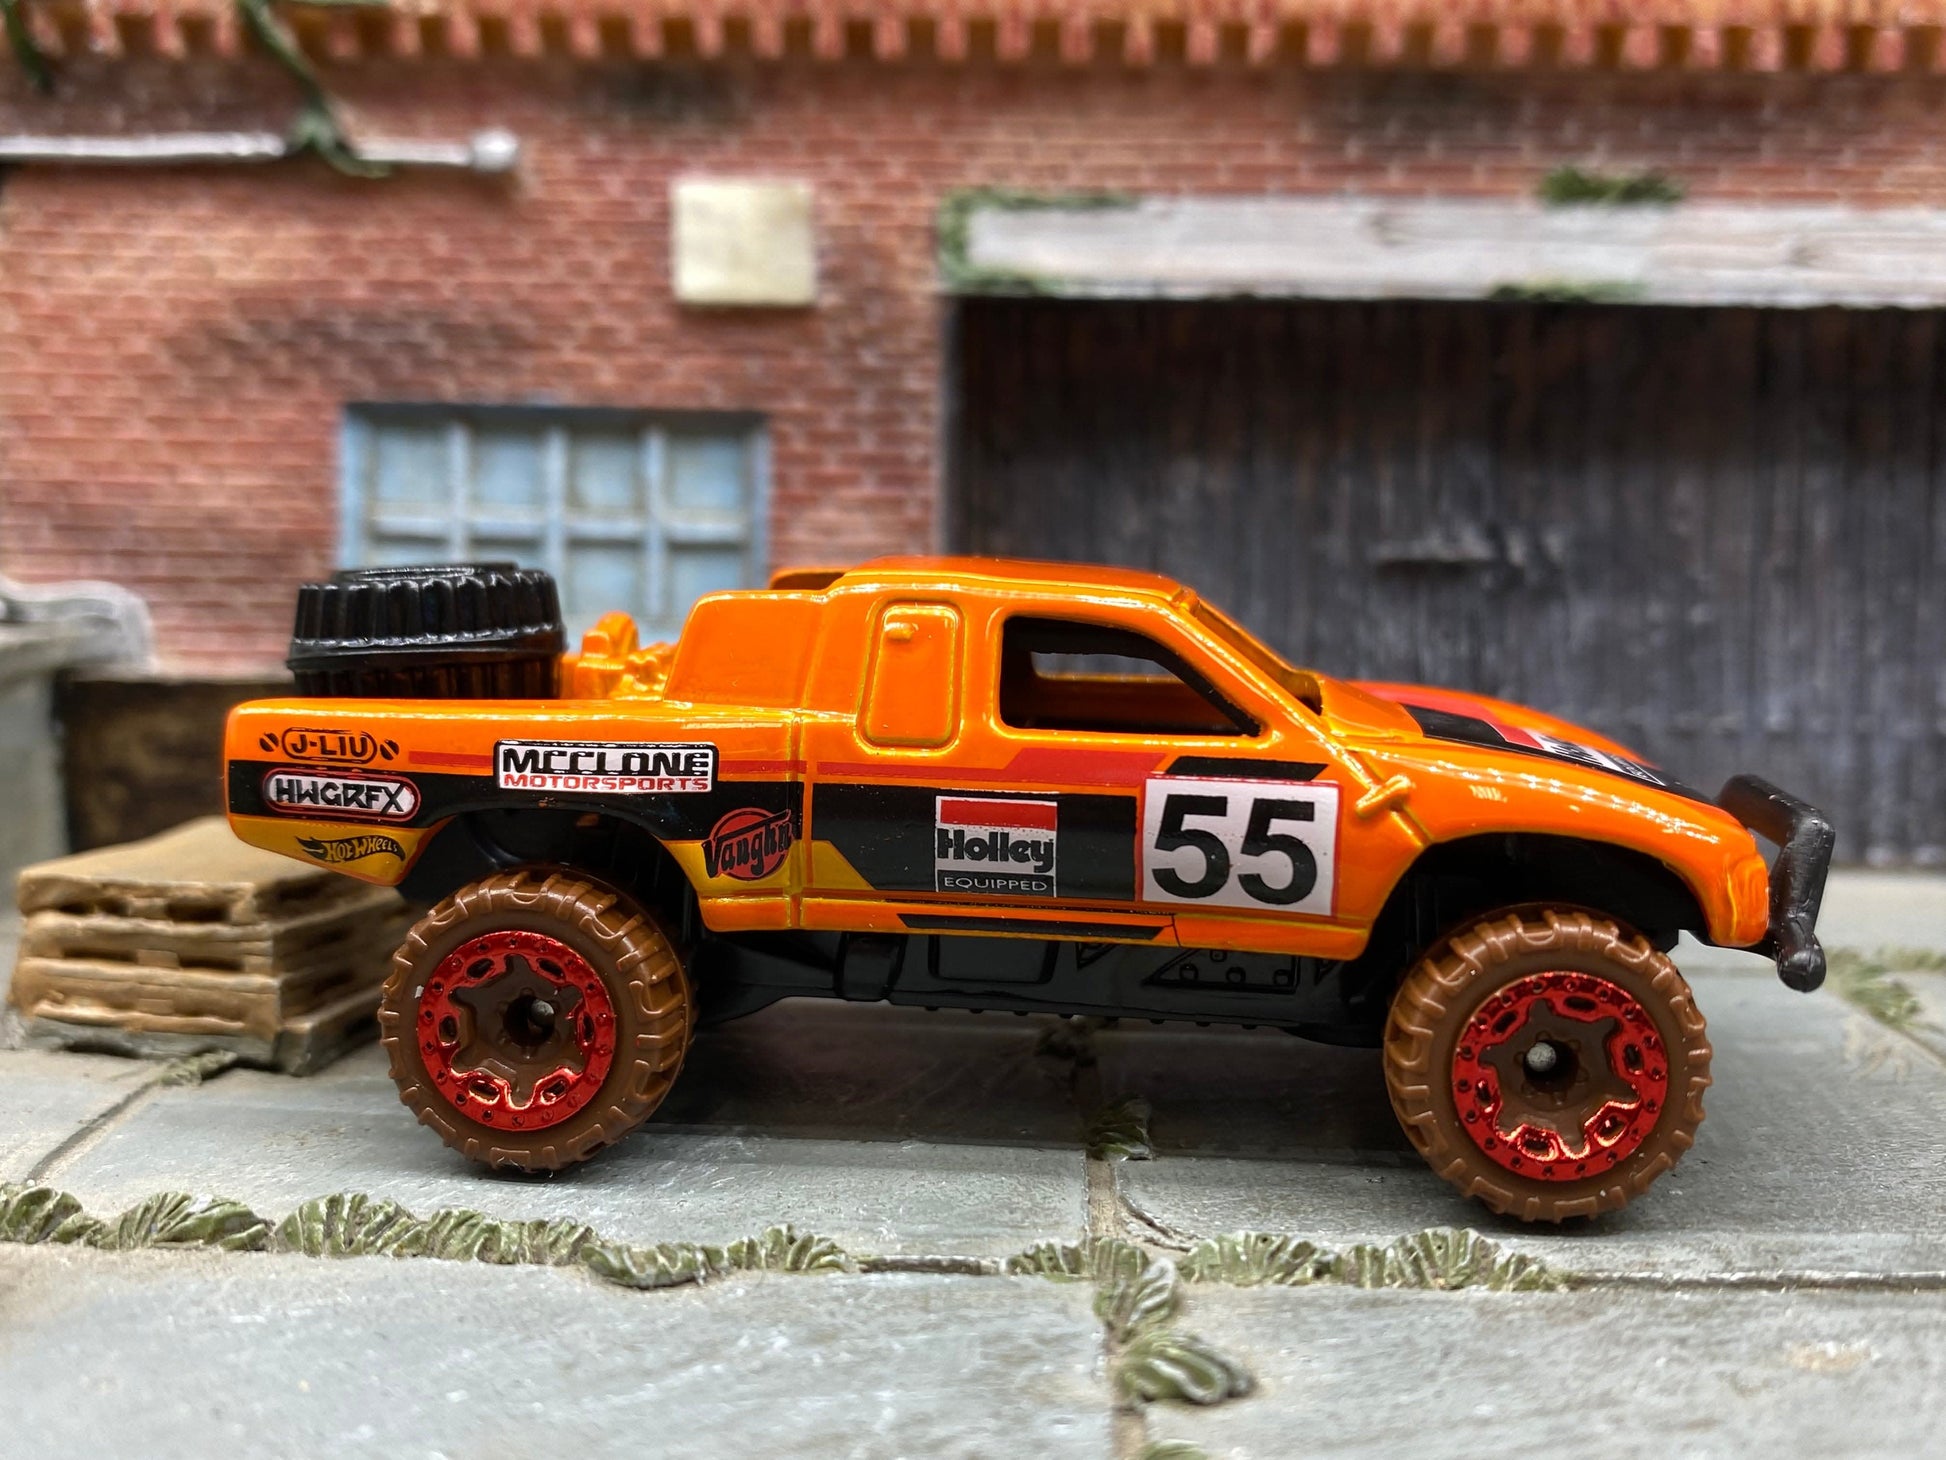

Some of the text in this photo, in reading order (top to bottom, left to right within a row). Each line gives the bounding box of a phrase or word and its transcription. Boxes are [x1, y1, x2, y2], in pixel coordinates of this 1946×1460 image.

[291, 734, 368, 758] J-LIU
[275, 778, 404, 815] HWGRFX
[503, 774, 709, 791] MOTORSPORTS
[937, 828, 1054, 874] Holley
[1152, 794, 1318, 906] 55
[944, 877, 1048, 891] EQUIPPED
